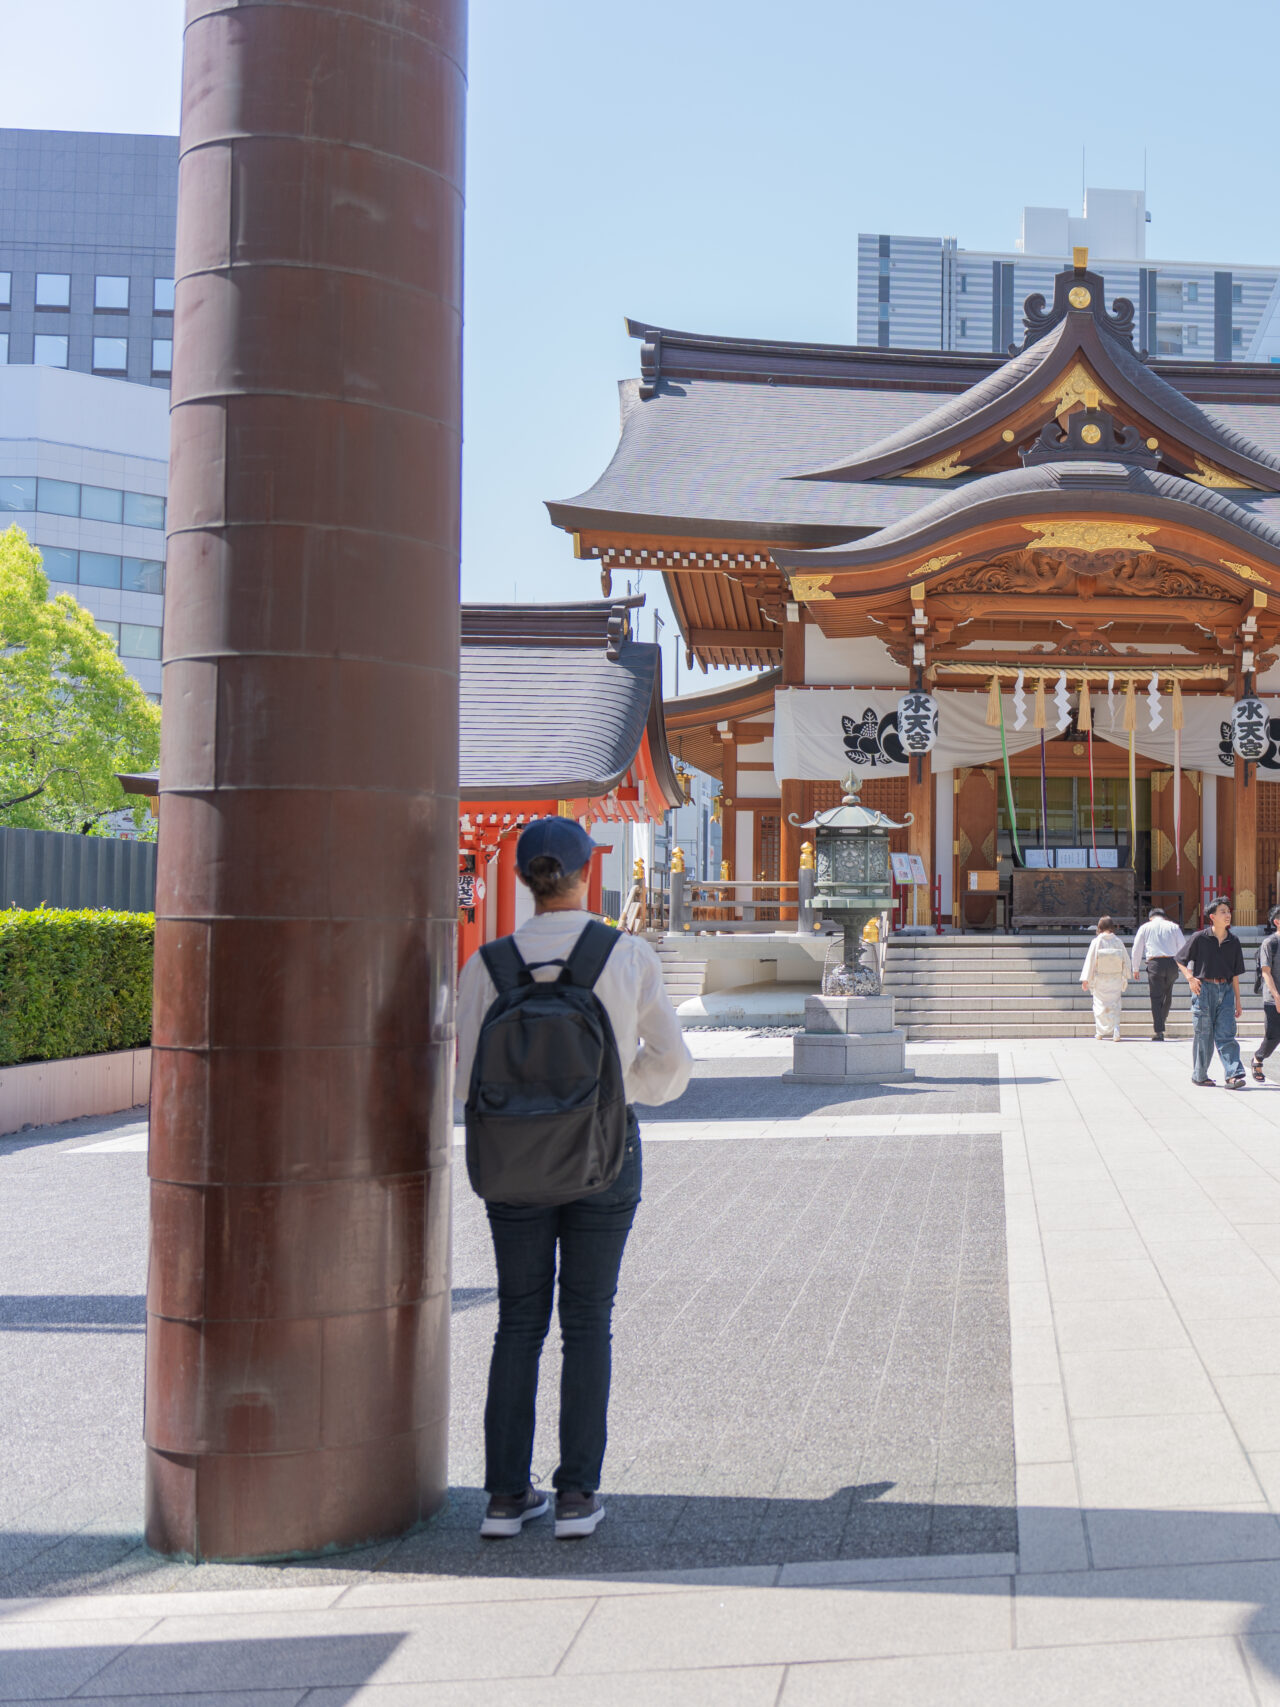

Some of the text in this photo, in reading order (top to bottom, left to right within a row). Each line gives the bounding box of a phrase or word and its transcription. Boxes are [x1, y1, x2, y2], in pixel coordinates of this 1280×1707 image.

[903, 695, 931, 750] 水天宮
[1237, 701, 1264, 757] 水天宮
